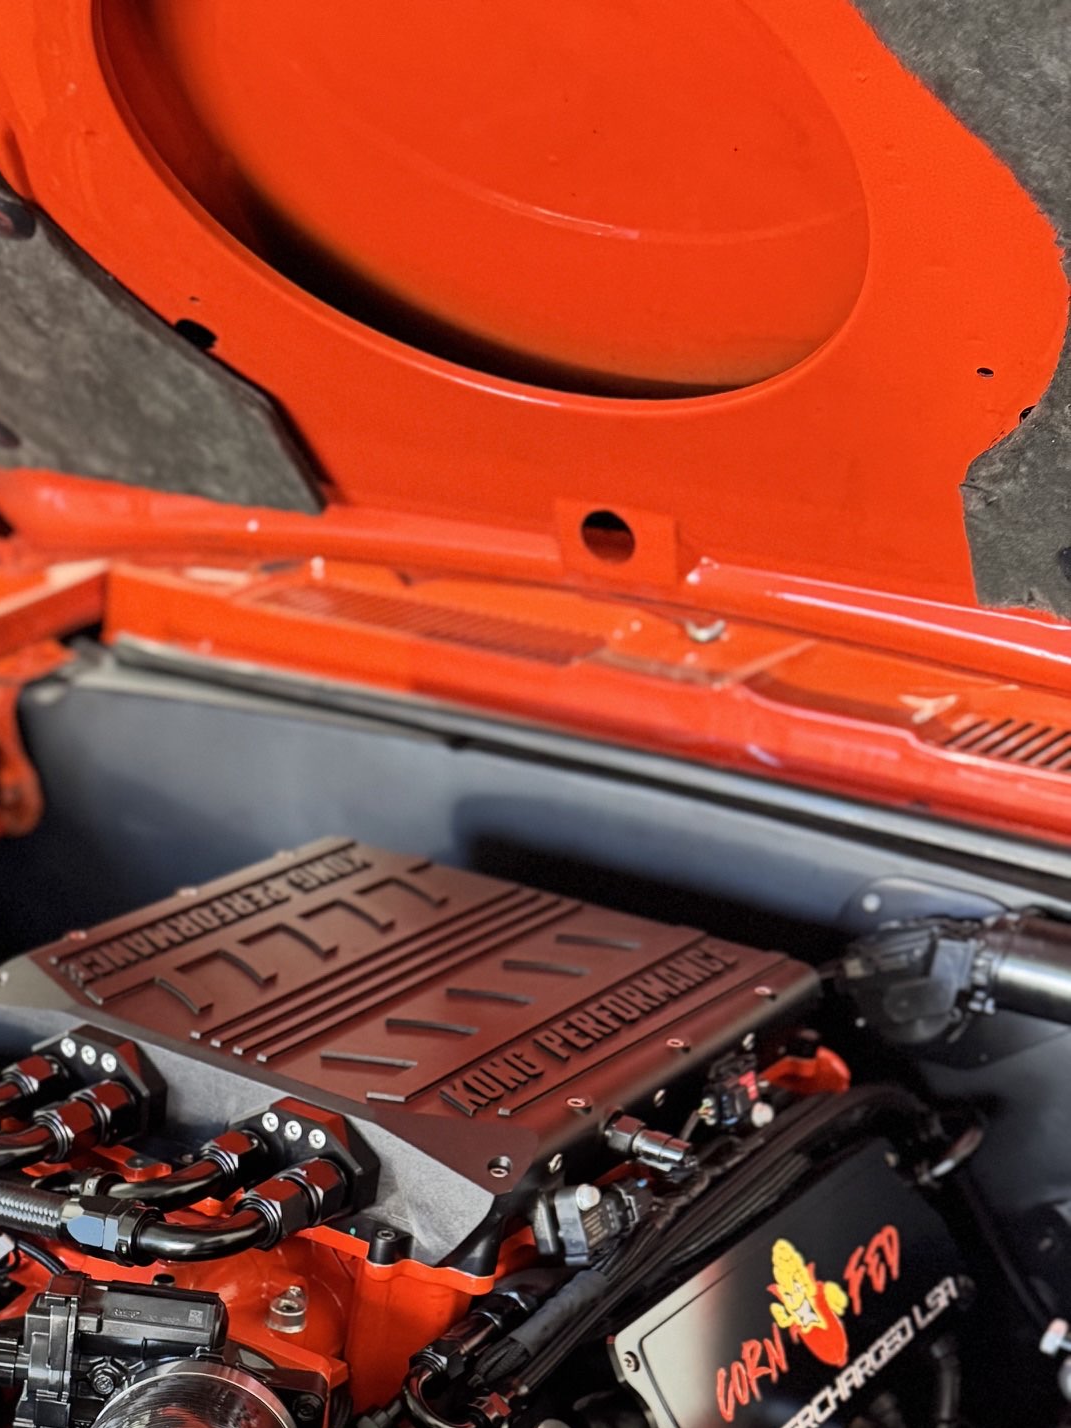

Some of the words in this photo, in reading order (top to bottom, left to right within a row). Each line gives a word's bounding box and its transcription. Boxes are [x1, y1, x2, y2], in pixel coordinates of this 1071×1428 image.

[287, 851, 373, 893] KONG
[60, 884, 292, 984] PERFORMANCE
[439, 1051, 545, 1117] KONG
[532, 943, 740, 1062] PERFORMANCE
[716, 1323, 789, 1422] CORN
[843, 1224, 900, 1316] FED
[912, 1276, 959, 1331] LSA
